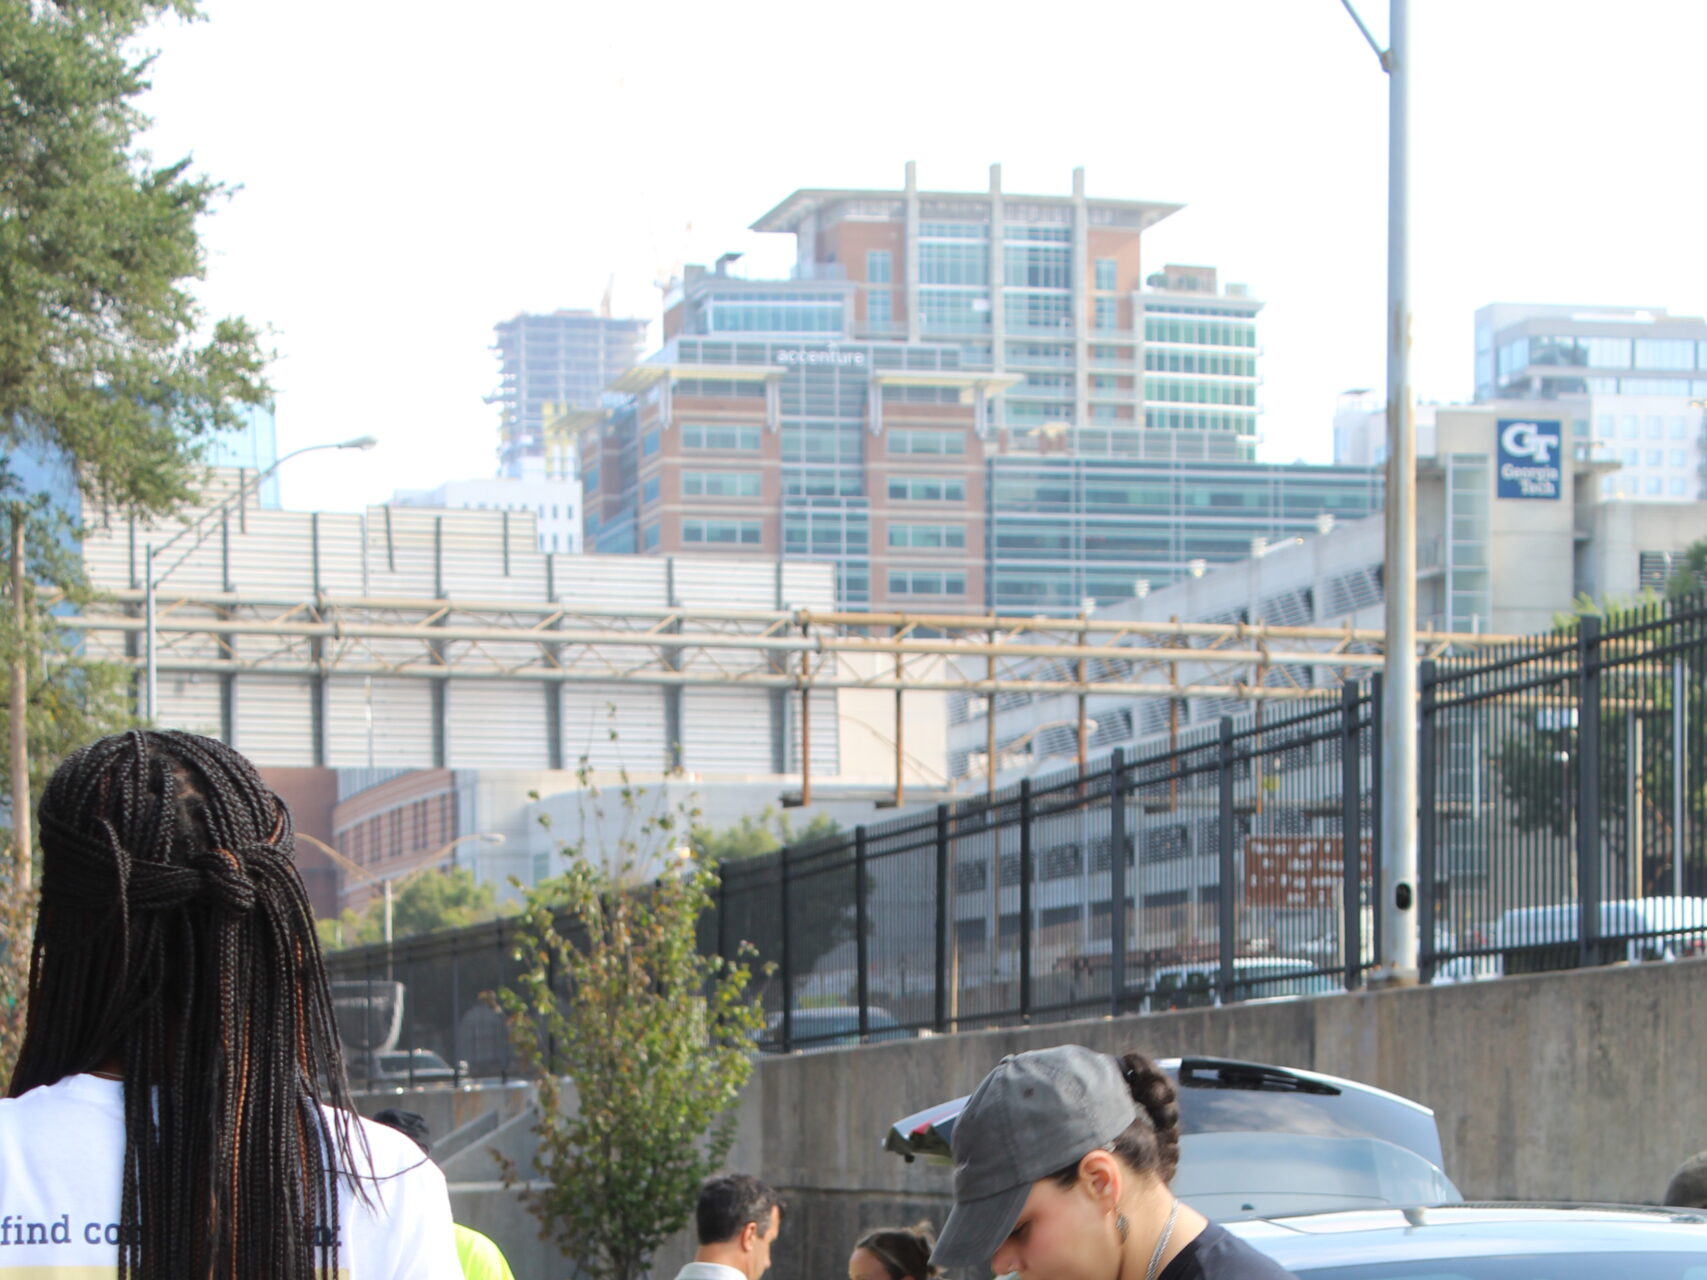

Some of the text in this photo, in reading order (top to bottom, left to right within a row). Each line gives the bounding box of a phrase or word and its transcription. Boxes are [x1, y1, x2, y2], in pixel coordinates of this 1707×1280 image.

[776, 347, 865, 367] accenture
[1501, 422, 1559, 463] GT
[1501, 463, 1559, 481] Georgia
[1520, 480, 1556, 496] Tech
[1, 1214, 72, 1245] find
